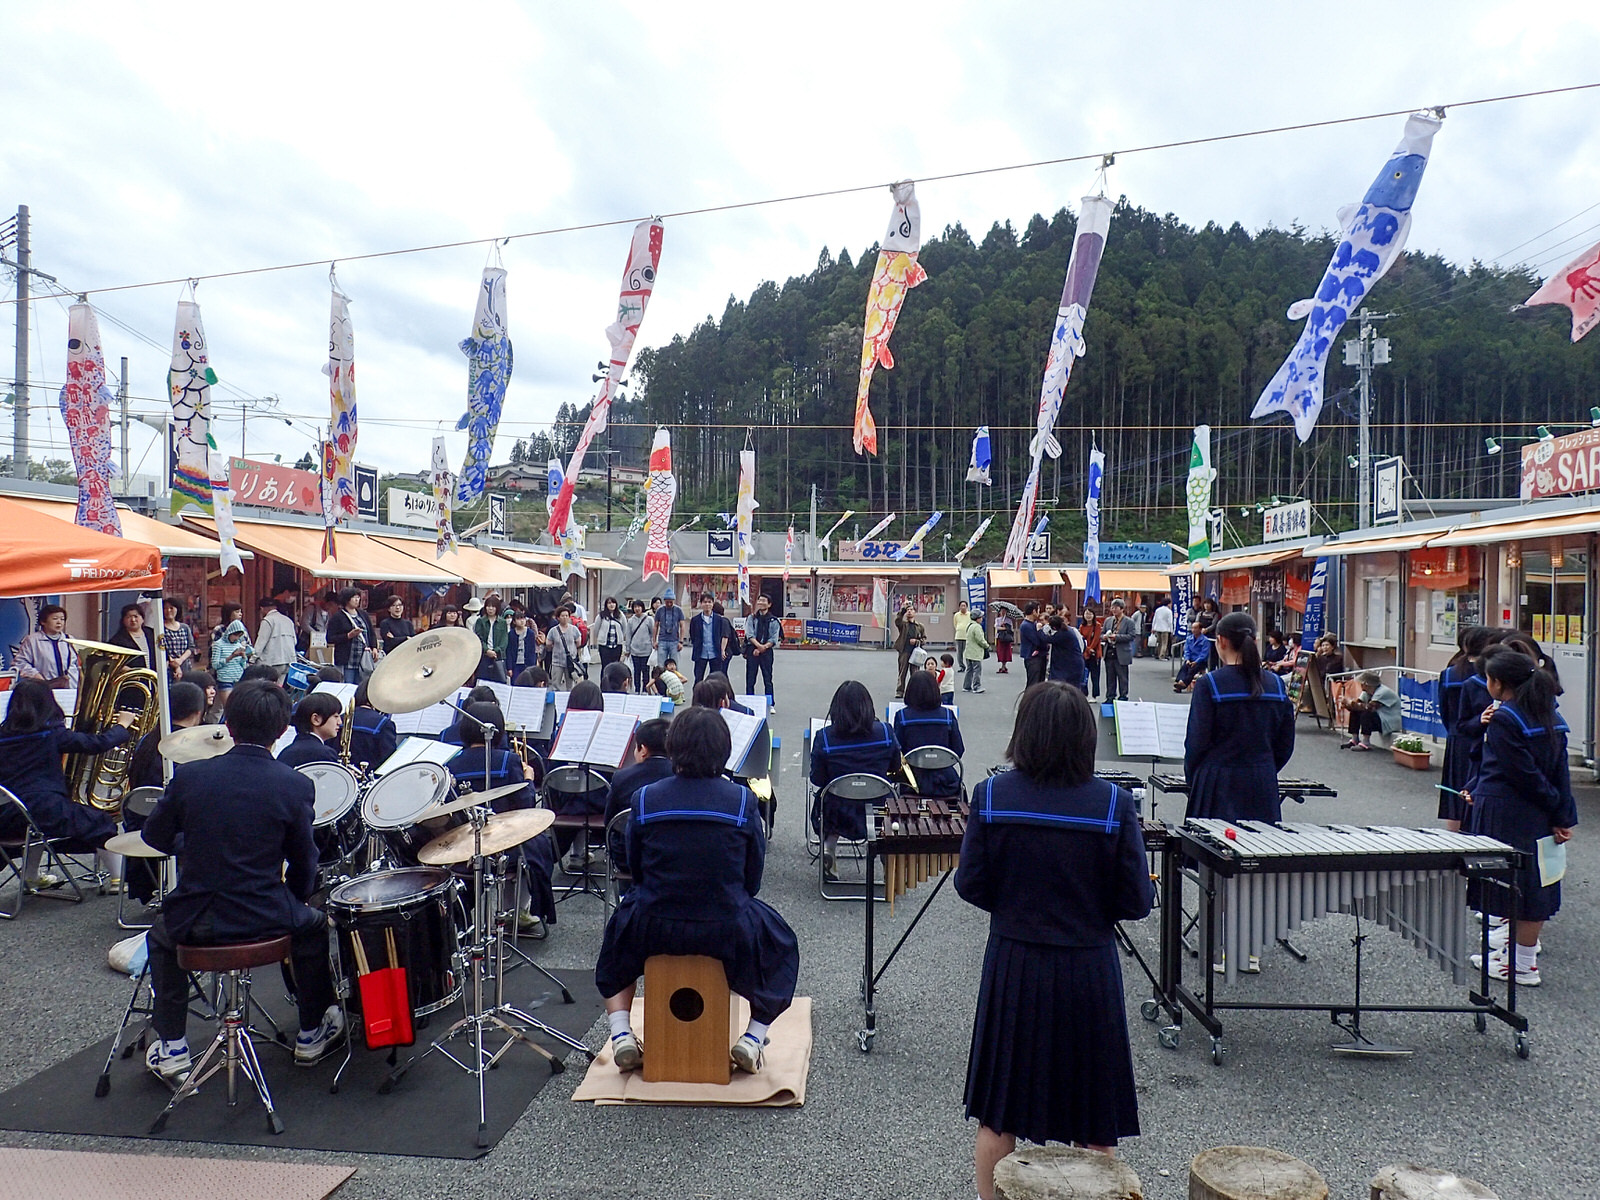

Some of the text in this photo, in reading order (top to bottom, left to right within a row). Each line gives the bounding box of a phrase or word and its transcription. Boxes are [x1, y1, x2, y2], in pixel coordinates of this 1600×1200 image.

[240, 473, 297, 505] りあん
[863, 542, 920, 558] みなと
